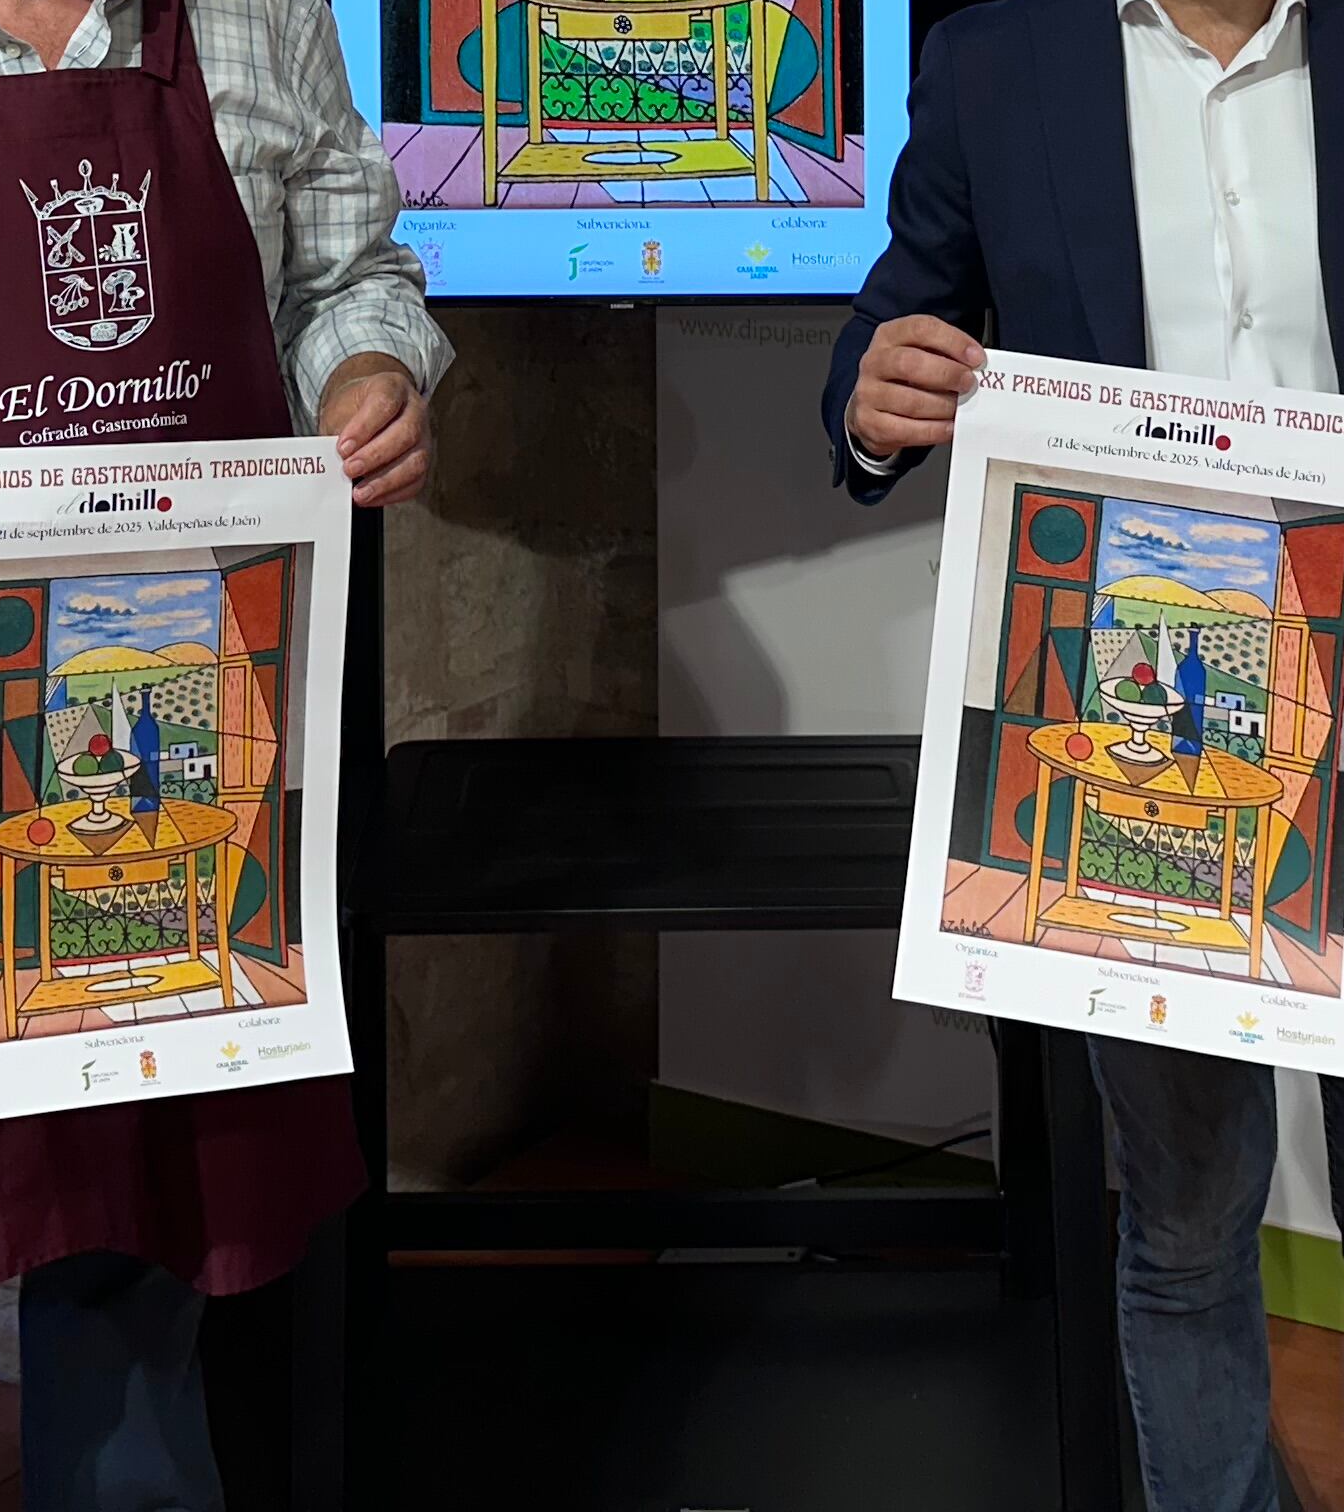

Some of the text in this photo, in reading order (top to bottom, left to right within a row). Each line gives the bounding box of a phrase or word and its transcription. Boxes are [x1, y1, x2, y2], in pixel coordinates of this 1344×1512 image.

[57, 360, 212, 413] Dornillo"
[979, 370, 1006, 390] XX
[1012, 374, 1092, 402] PREMIOS
[1099, 386, 1122, 405] DE
[1130, 390, 1266, 424] GASTRONOMÍA
[19, 411, 188, 445] Cofradía Gastronómica
[40, 468, 64, 487] DE
[71, 457, 203, 486] GASTRONOMÍA
[210, 456, 326, 479] TRADICIONAL
[1065, 438, 1080, 451] de
[1082, 441, 1150, 462] septiembre
[1153, 449, 1167, 462] de
[1205, 455, 1274, 478] Valdepeñas
[1275, 465, 1290, 478] de
[1291, 467, 1326, 485] Jaén)
[9, 528, 24, 539] de
[27, 525, 95, 541] septiembre
[97, 522, 112, 535] de
[147, 517, 212, 535] Valdepeñas
[215, 515, 229, 528] de
[229, 515, 261, 528] Jaén)
